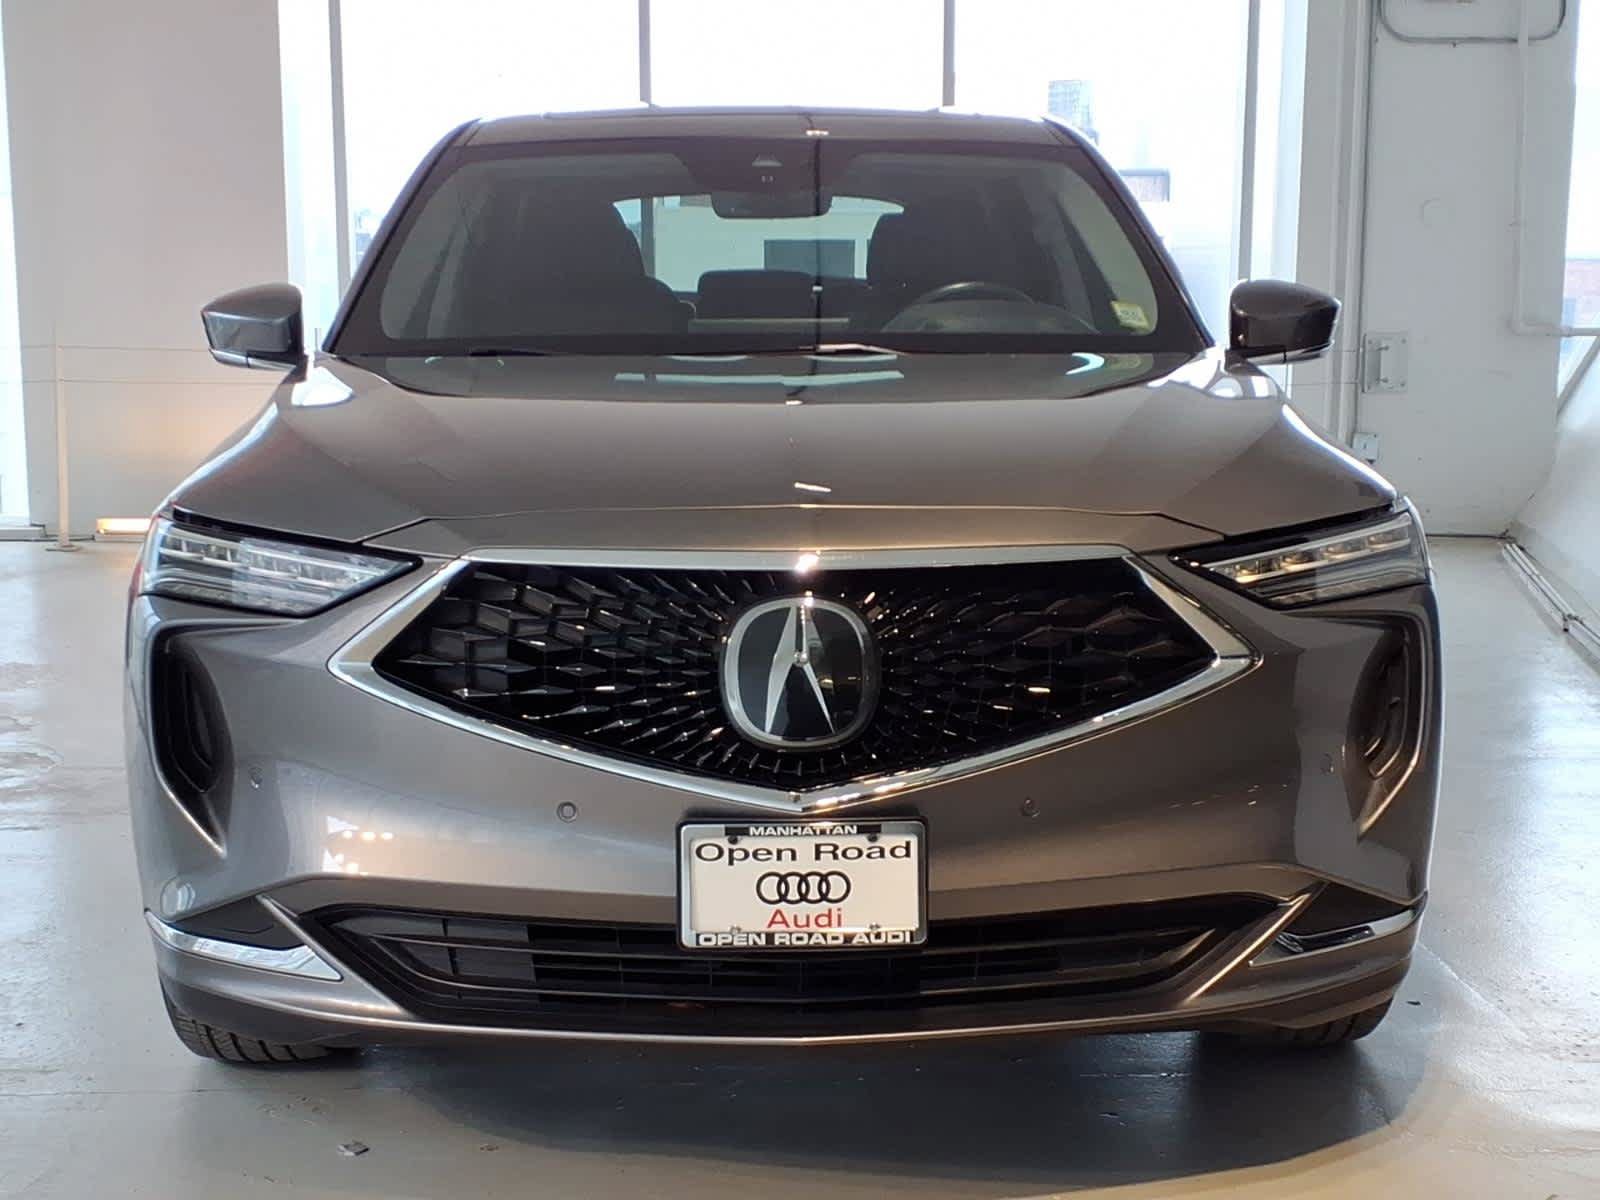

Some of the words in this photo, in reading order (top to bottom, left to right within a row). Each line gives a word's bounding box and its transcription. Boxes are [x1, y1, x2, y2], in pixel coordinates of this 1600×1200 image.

[750, 825, 857, 836] MANHATTAN
[695, 843, 797, 866] Open
[814, 841, 911, 861] Road
[767, 908, 843, 928] Audi
[699, 932, 766, 946] OPEN
[774, 931, 844, 945] ROAD
[852, 930, 911, 943] AUDI
